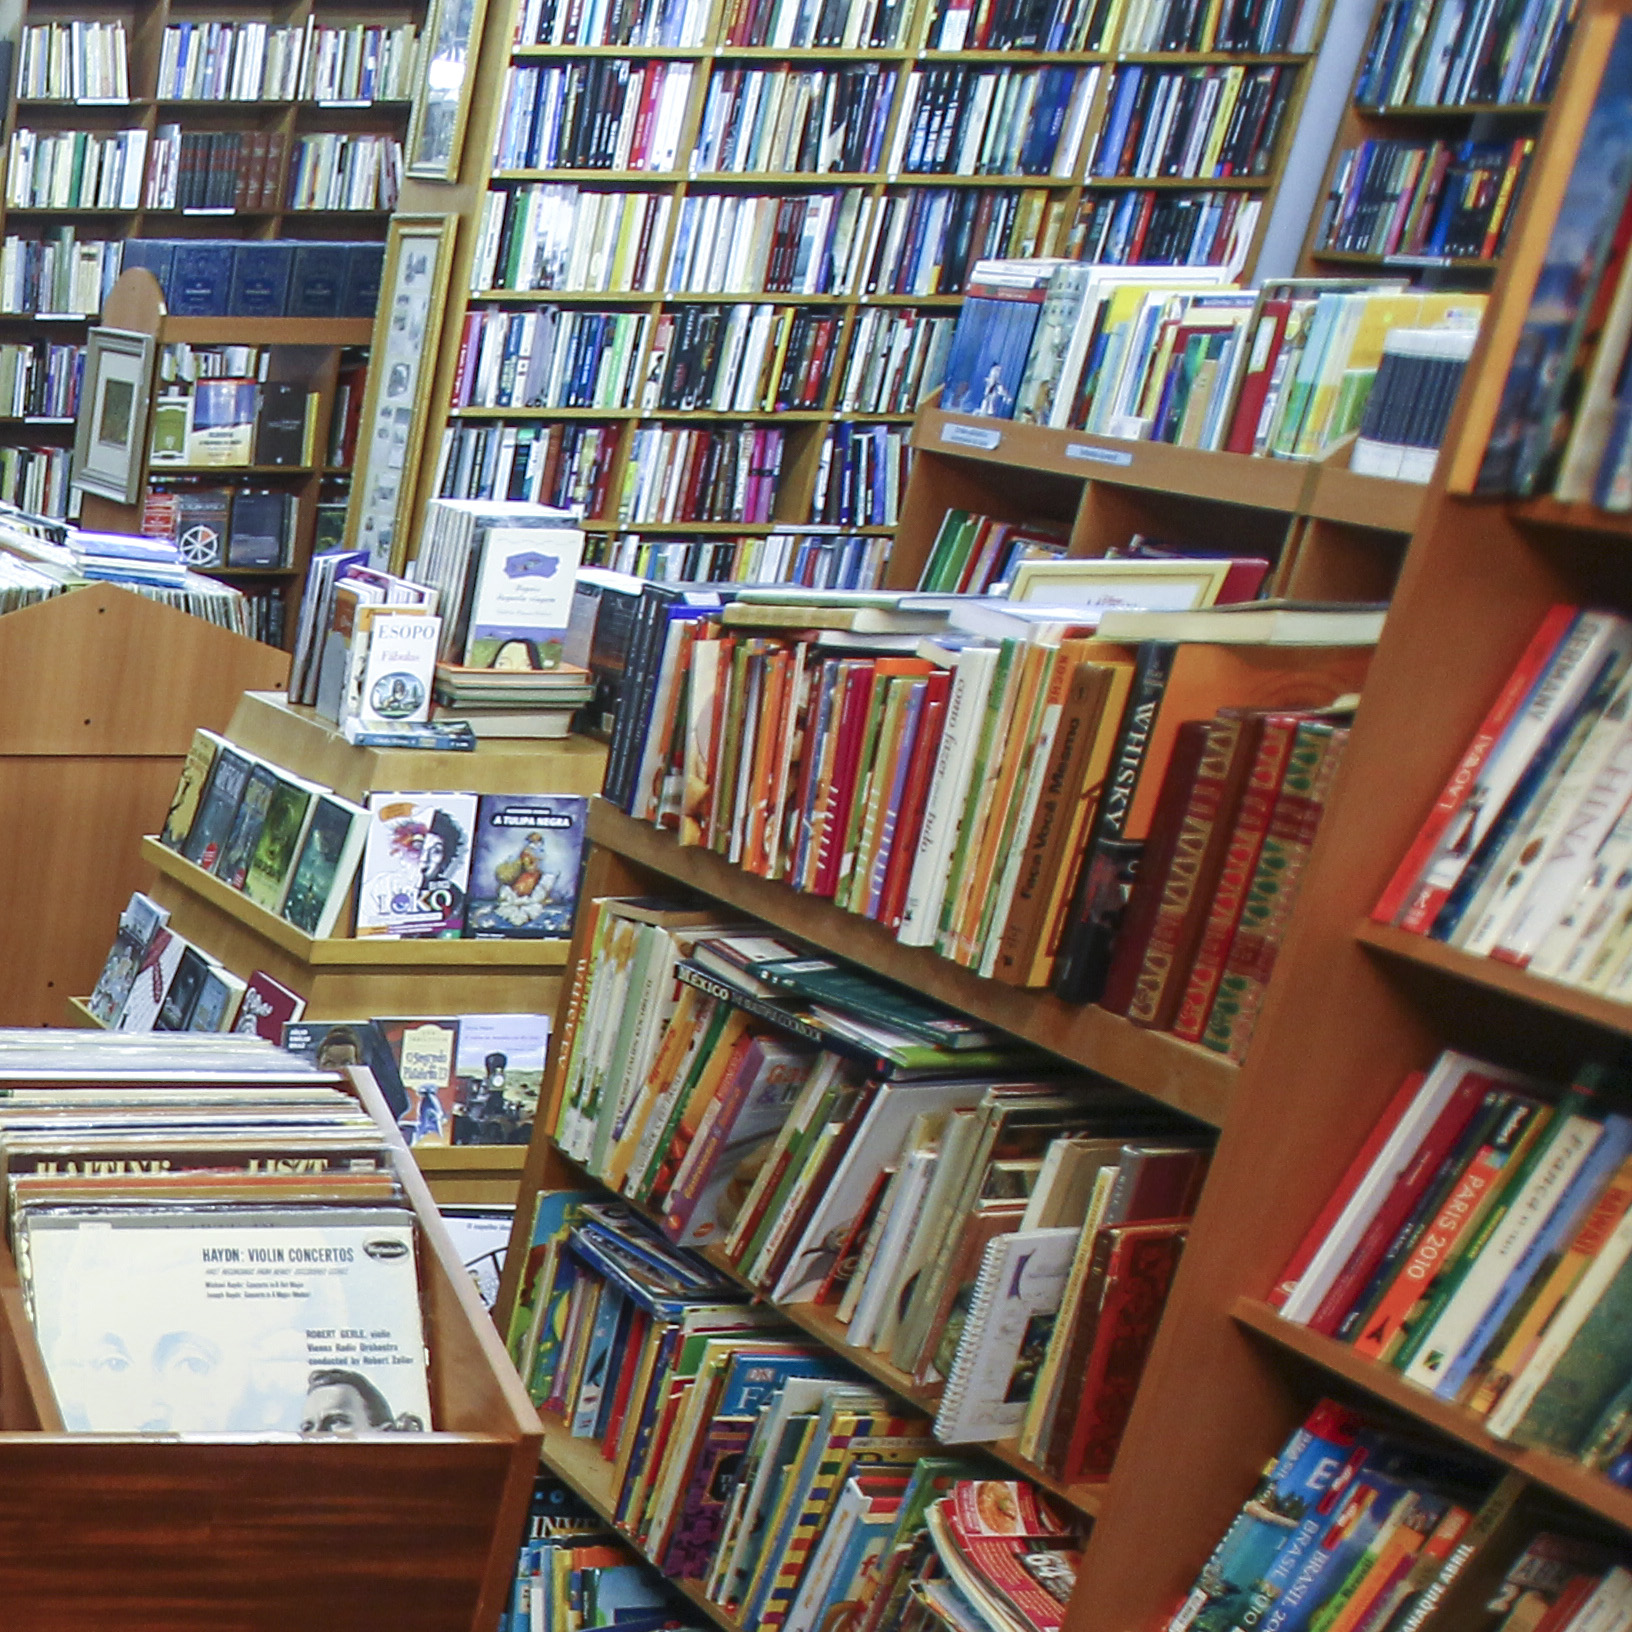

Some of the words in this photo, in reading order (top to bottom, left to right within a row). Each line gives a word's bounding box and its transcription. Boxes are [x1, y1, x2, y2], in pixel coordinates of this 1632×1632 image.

[378, 625, 434, 640] ESOPO
[1531, 621, 1600, 721] GERMANY
[948, 678, 965, 728] como
[937, 730, 958, 779] fazer
[1105, 702, 1155, 831] WHISKY
[504, 816, 534, 826] TULIPA
[536, 818, 570, 827] NEGRA
[919, 811, 937, 853] tudo
[1020, 855, 1041, 899] Faça
[1034, 800, 1058, 851] Você
[1049, 717, 1080, 794] Mesmo
[1438, 1173, 1485, 1231] PARIS
[202, 1248, 245, 1263] HAYDN:
[248, 1248, 285, 1263] VIOLIN
[289, 1248, 354, 1263] CONCERTOS
[1406, 1237, 1446, 1280] 2010
[306, 1329, 336, 1339] ROBERT
[1272, 1519, 1320, 1580] BRASIL
[1439, 1542, 1475, 1586] ABRIL
[1285, 1549, 1331, 1607] BRASIL
